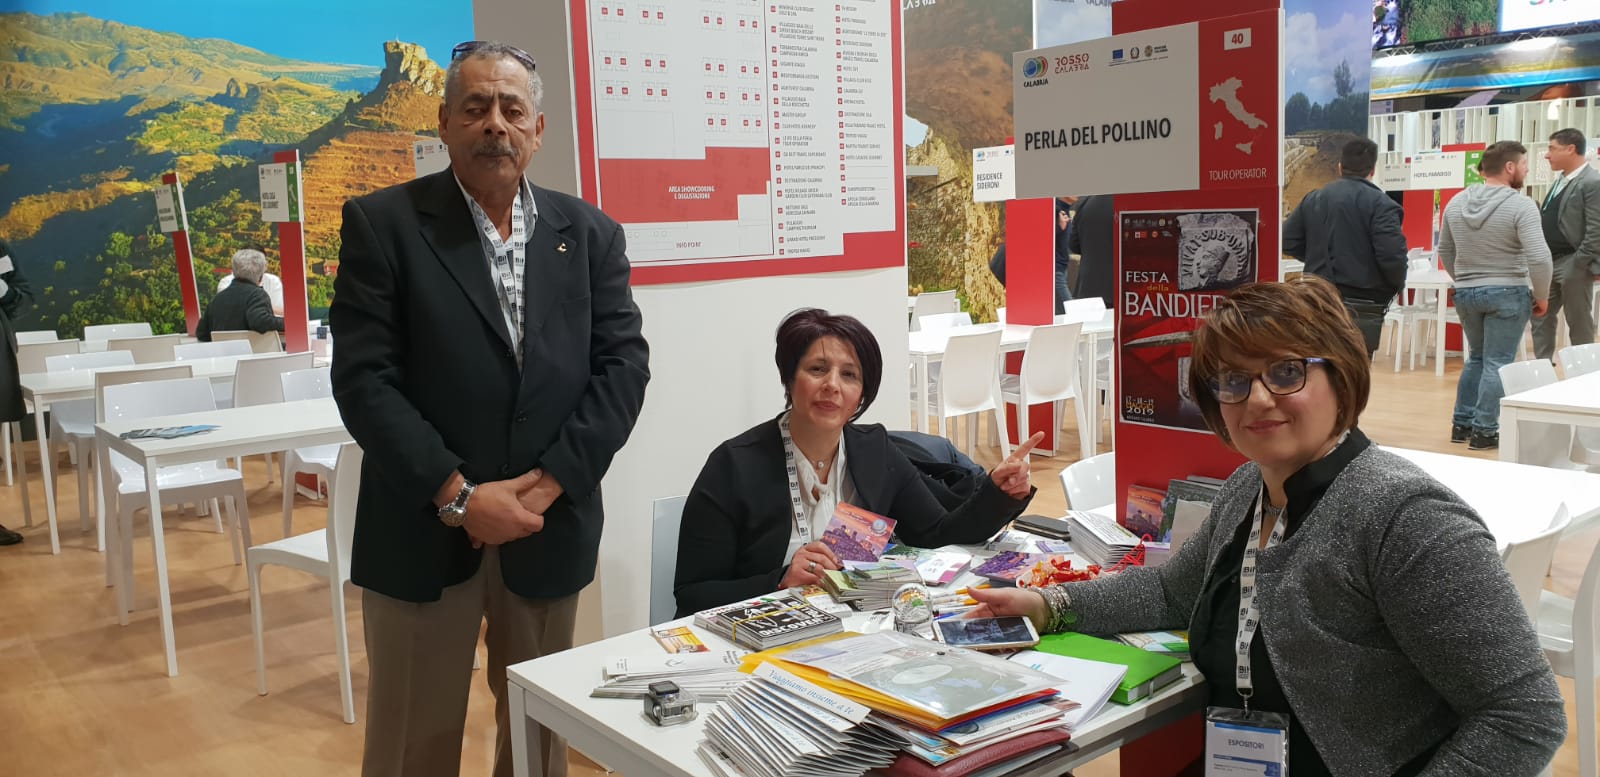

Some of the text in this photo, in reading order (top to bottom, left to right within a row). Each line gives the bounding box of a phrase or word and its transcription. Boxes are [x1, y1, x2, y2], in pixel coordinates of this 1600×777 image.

[1231, 33, 1244, 44] 40
[1054, 53, 1090, 67] ROSSO
[1023, 78, 1048, 88] CALABRIA
[1025, 117, 1171, 151] PERLA DEL POLLINO
[977, 172, 1002, 180] RESIDENCE
[1209, 167, 1266, 180] TOUR OPERATOR
[1126, 271, 1169, 283] FESTA
[1146, 284, 1170, 292] della
[759, 617, 823, 636] DISCOVER
[769, 670, 807, 692] Viaggiamo
[807, 690, 838, 706] insieme
[844, 706, 855, 714] te
[1228, 738, 1264, 750] ESPOSITORI
